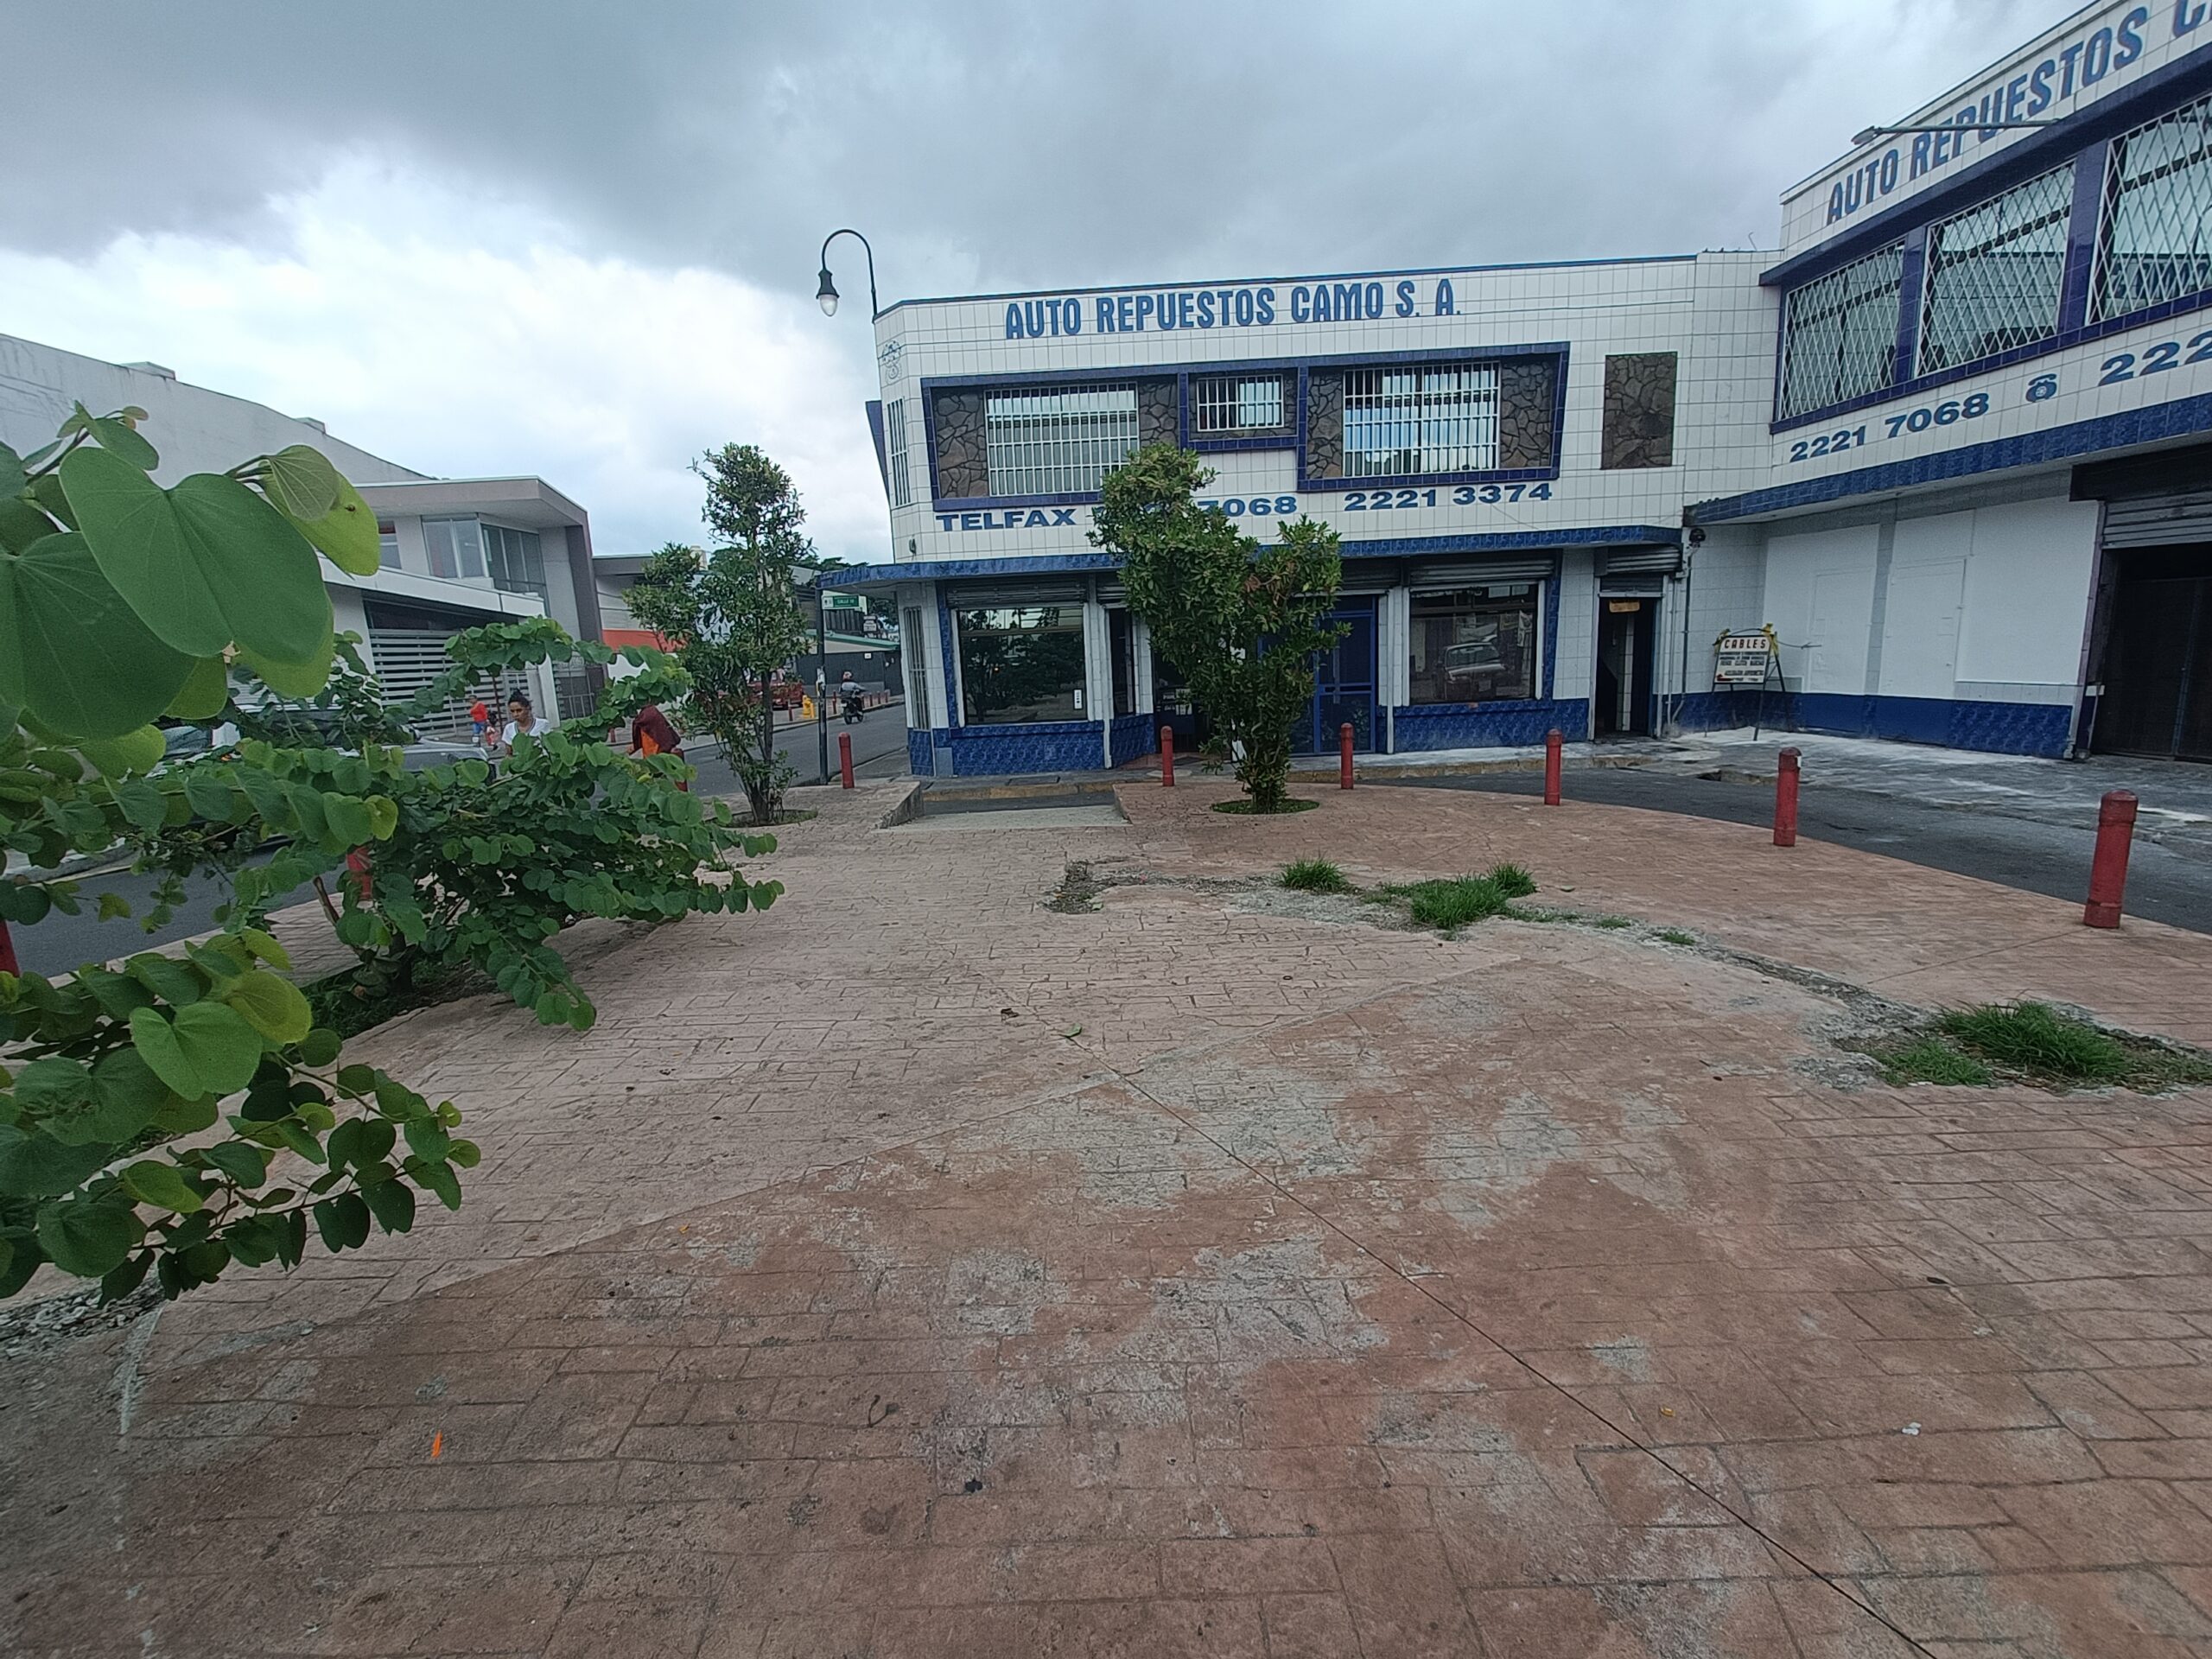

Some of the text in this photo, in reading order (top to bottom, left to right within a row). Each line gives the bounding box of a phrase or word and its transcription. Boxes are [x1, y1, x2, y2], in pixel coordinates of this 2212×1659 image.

[1826, 149, 1899, 226] AUTO
[1908, 6, 2148, 183] REPUESTOS
[1006, 278, 1461, 340] AUTO REPUESTOS CAMO S. A.
[1789, 392, 1990, 463] 2221 7068
[935, 508, 1077, 532] TELFAX
[1344, 482, 1553, 512] 2221 3374
[1724, 639, 1767, 649] CABLES
